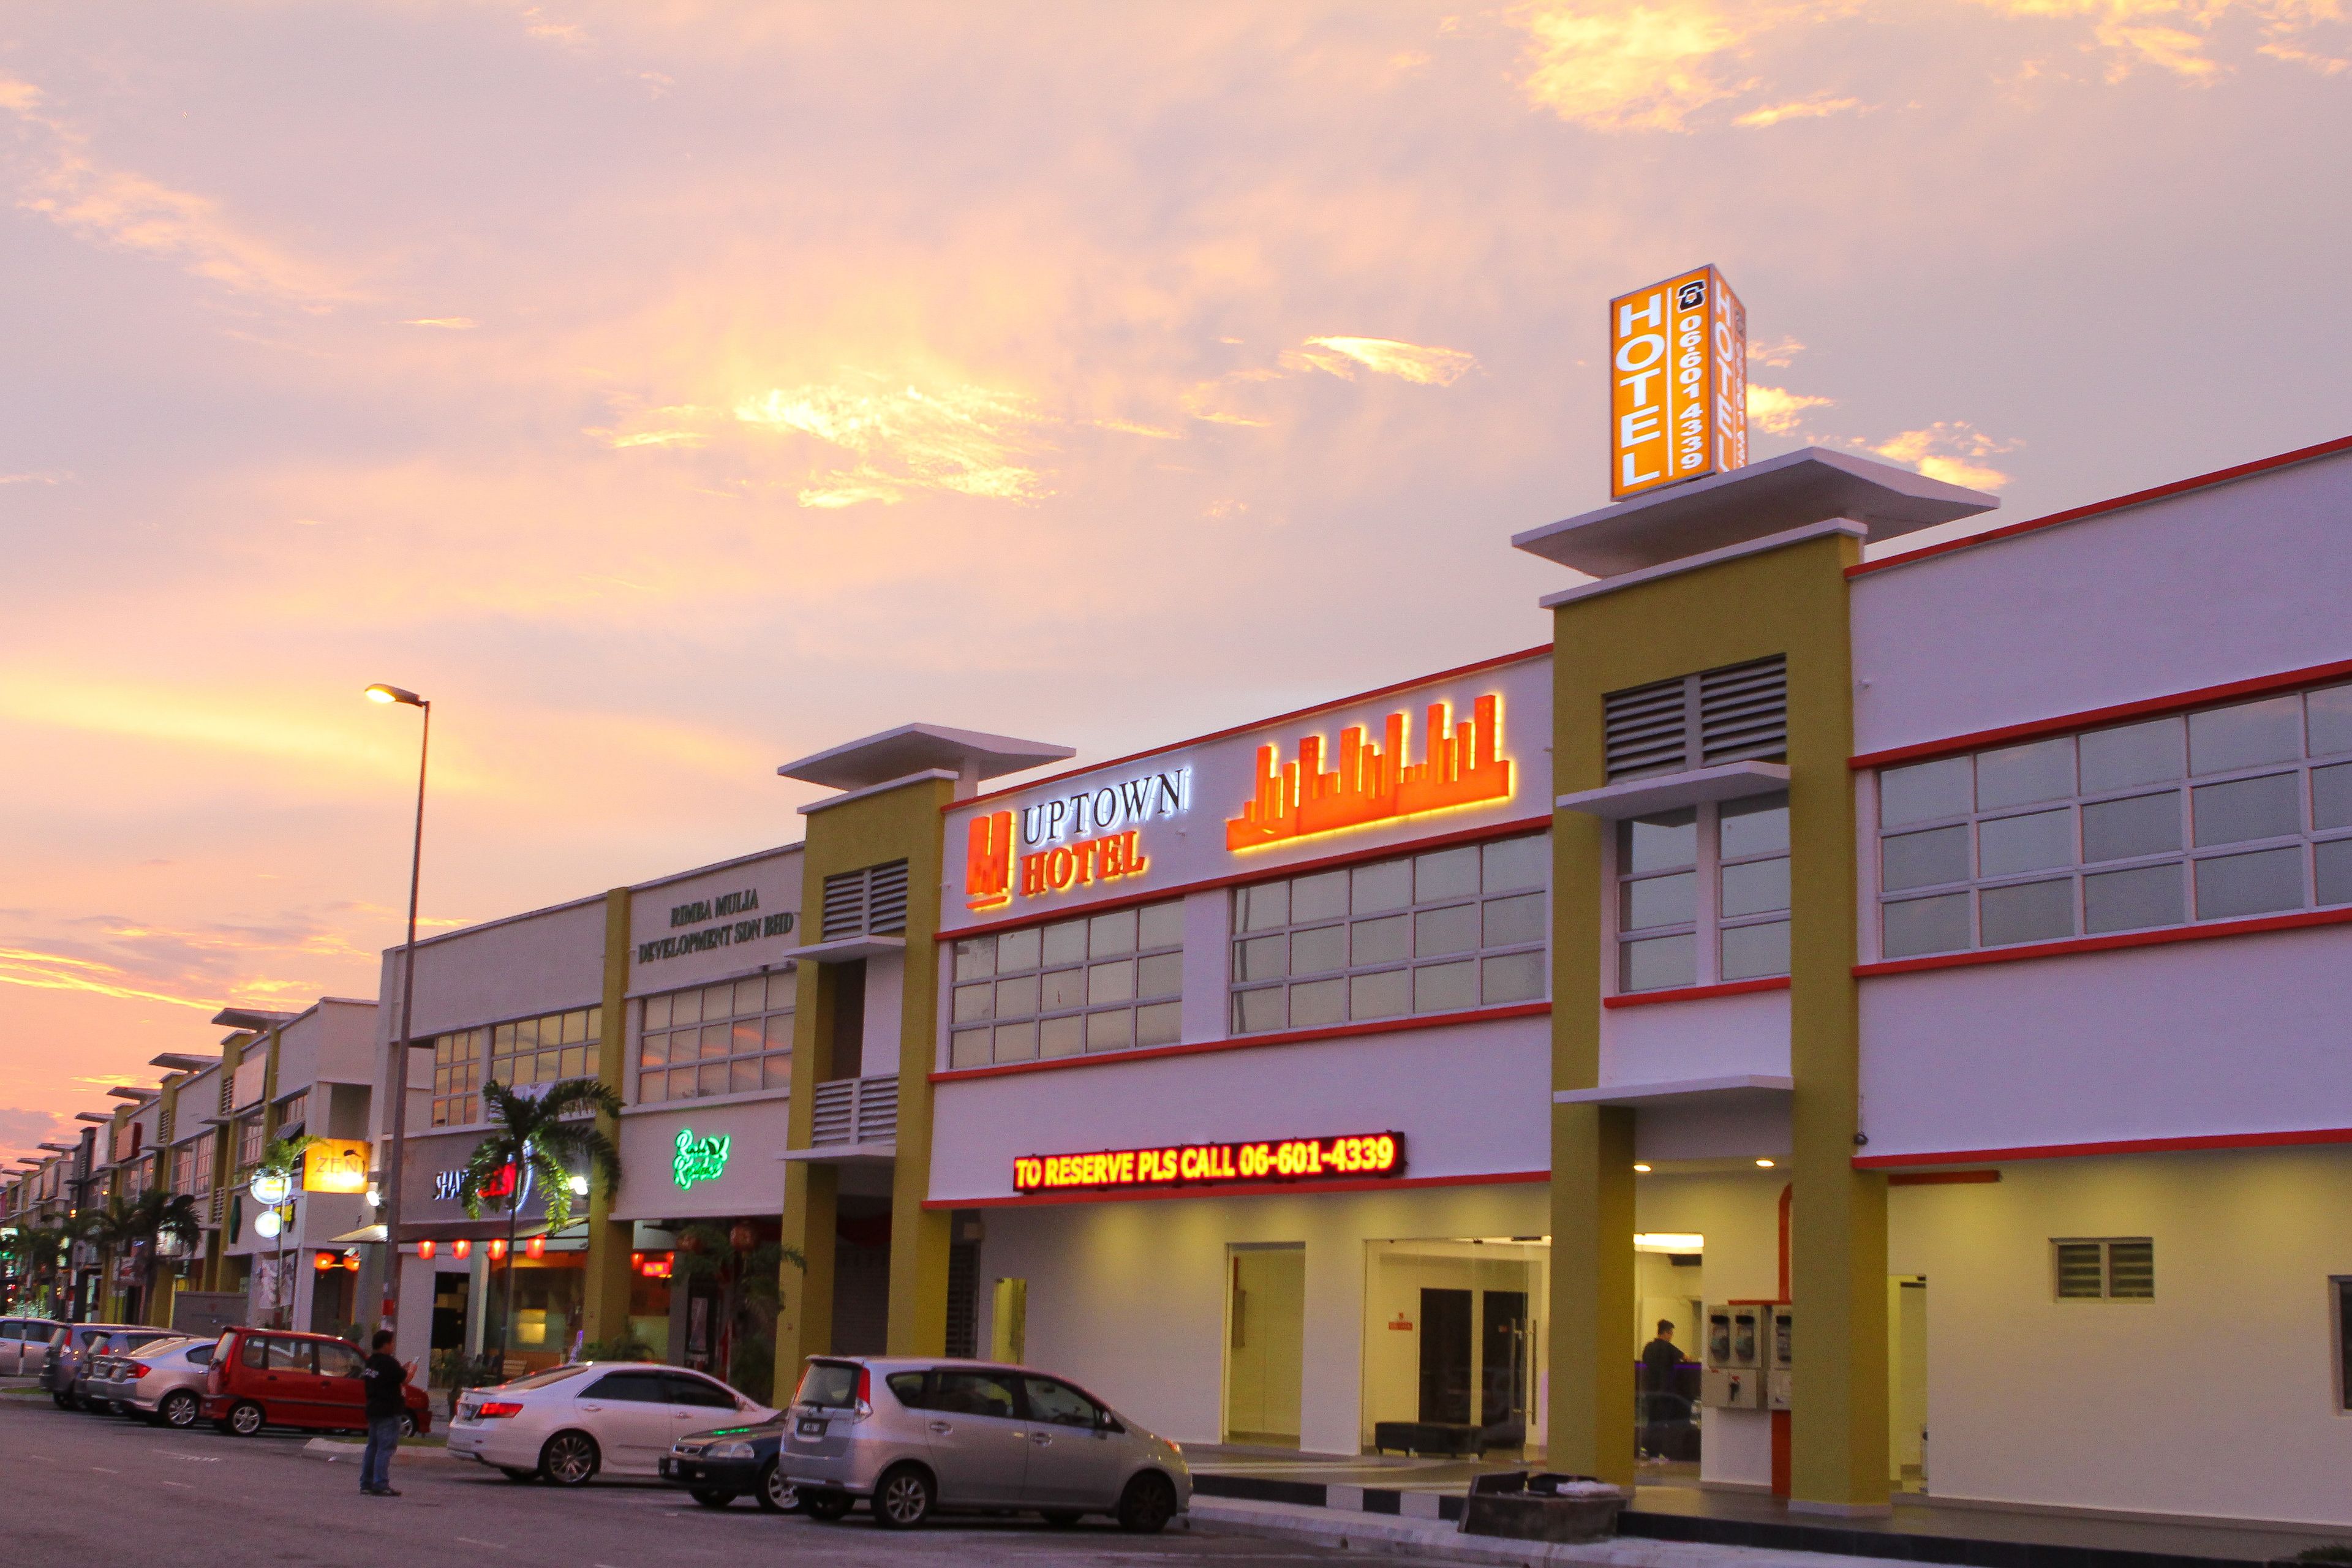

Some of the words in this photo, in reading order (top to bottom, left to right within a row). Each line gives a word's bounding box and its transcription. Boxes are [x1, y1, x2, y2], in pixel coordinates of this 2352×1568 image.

[1616, 293, 1665, 487] HOTEL
[1715, 281, 1733, 472] HOTEL
[1022, 768, 1185, 845] UPTOWN
[1019, 831, 1145, 897] HOTEL
[638, 924, 733, 963] DEVELOPMENT
[734, 918, 762, 943] SDN
[764, 911, 794, 938] BHD
[670, 899, 713, 928] RIMBA
[315, 1156, 358, 1173] ZEN
[1014, 1158, 1042, 1188] TO
[1044, 1152, 1134, 1186] RESERVE
[1137, 1148, 1178, 1182] PLS
[1180, 1145, 1236, 1179] CALL
[1238, 1136, 1395, 1176] 06-601-4339
